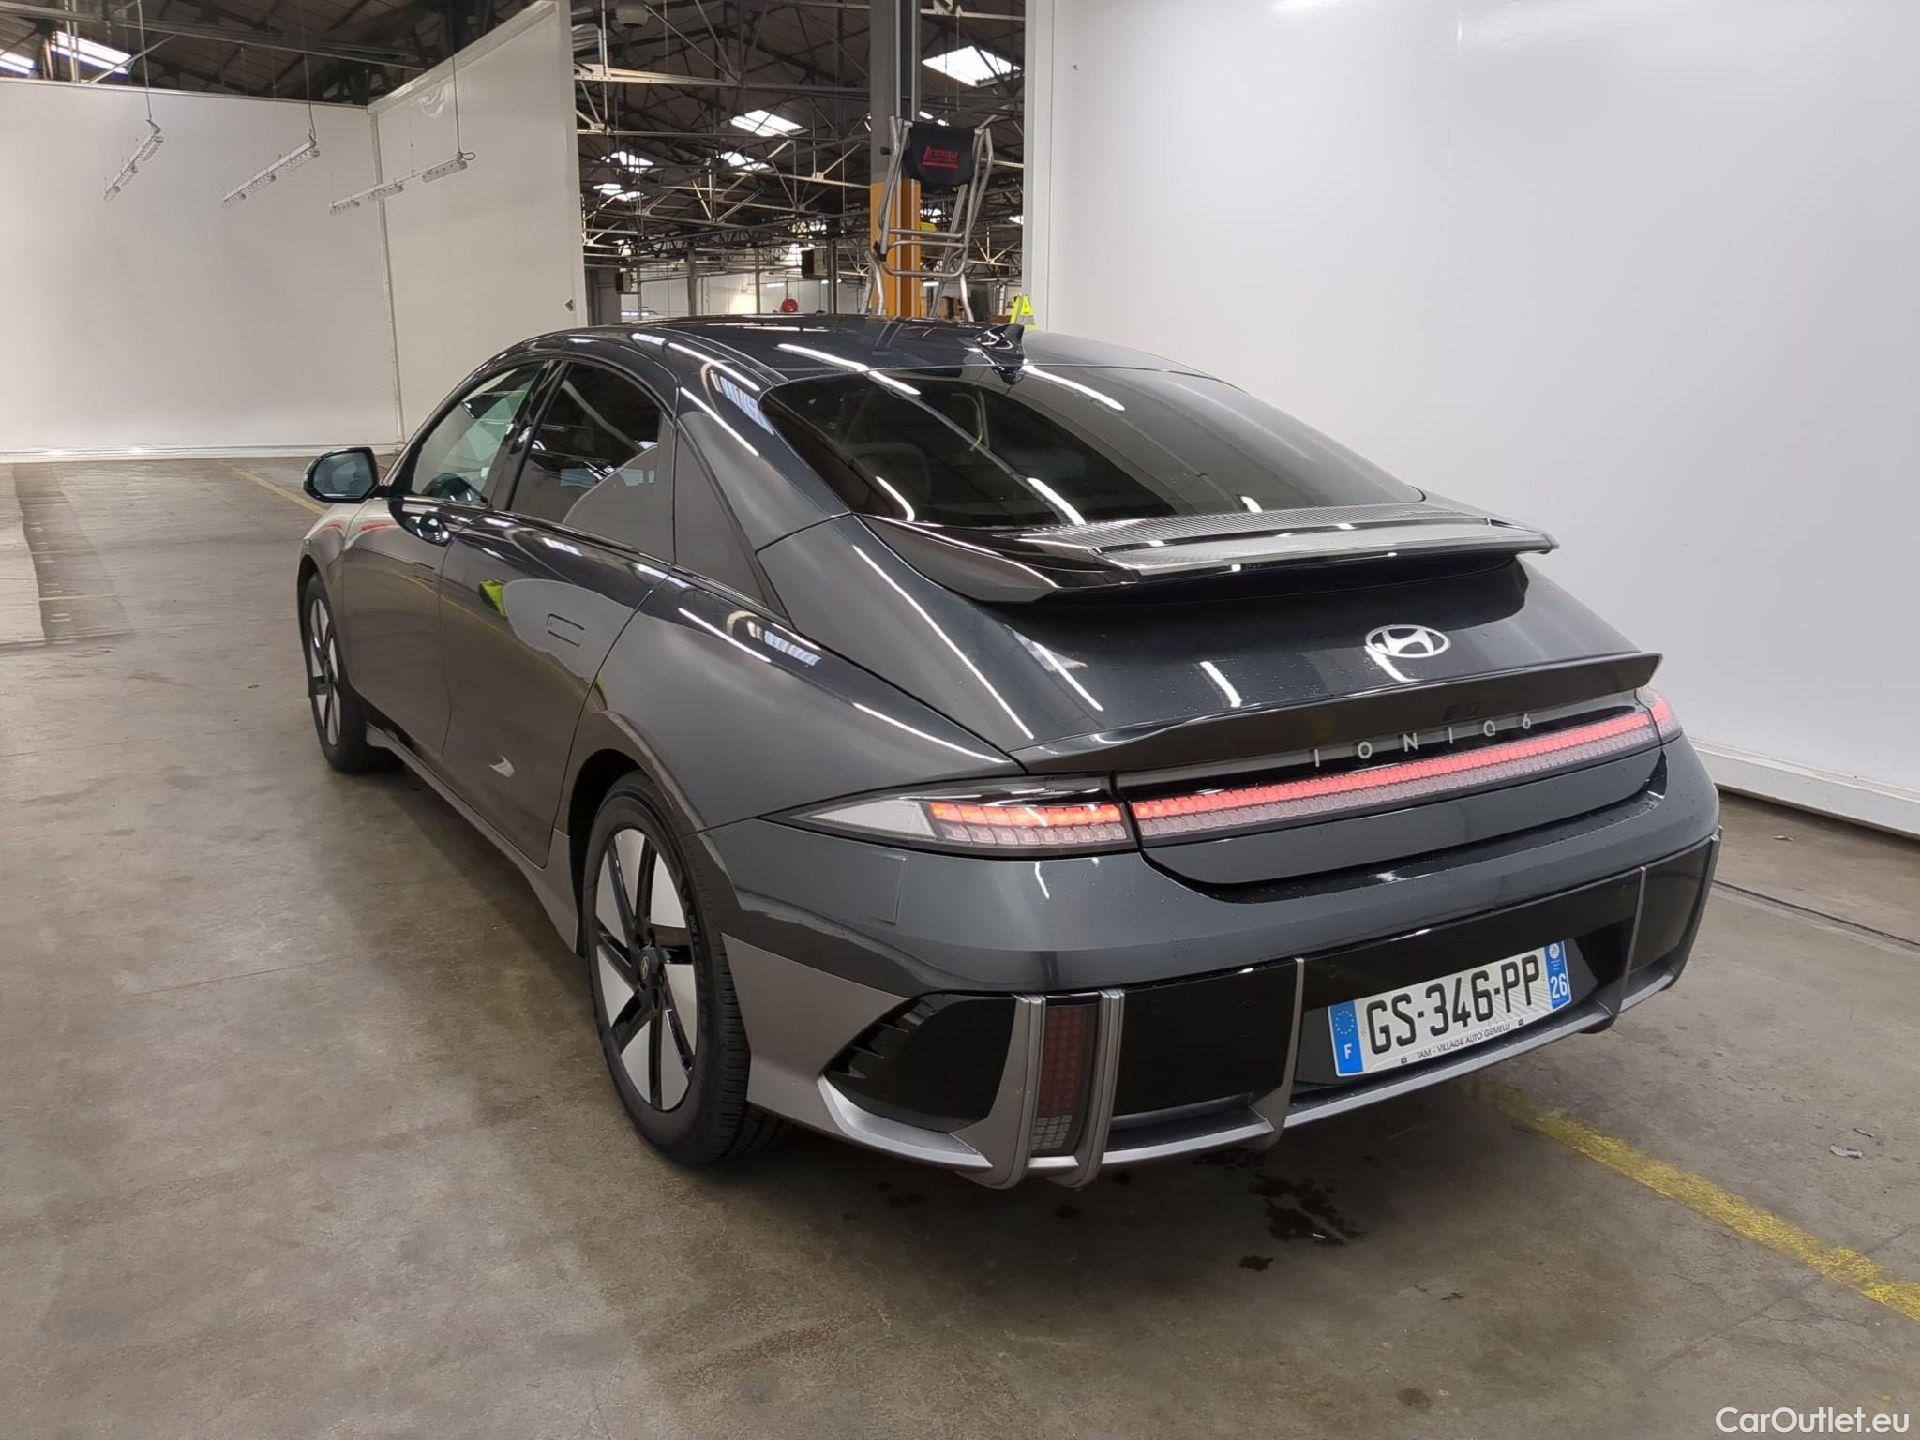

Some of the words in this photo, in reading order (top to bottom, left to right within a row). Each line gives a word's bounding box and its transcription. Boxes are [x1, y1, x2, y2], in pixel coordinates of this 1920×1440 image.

[1549, 972, 1570, 998] 26
[1366, 954, 1539, 1055] GS-346-PP
[1344, 1043, 1352, 1060] F
